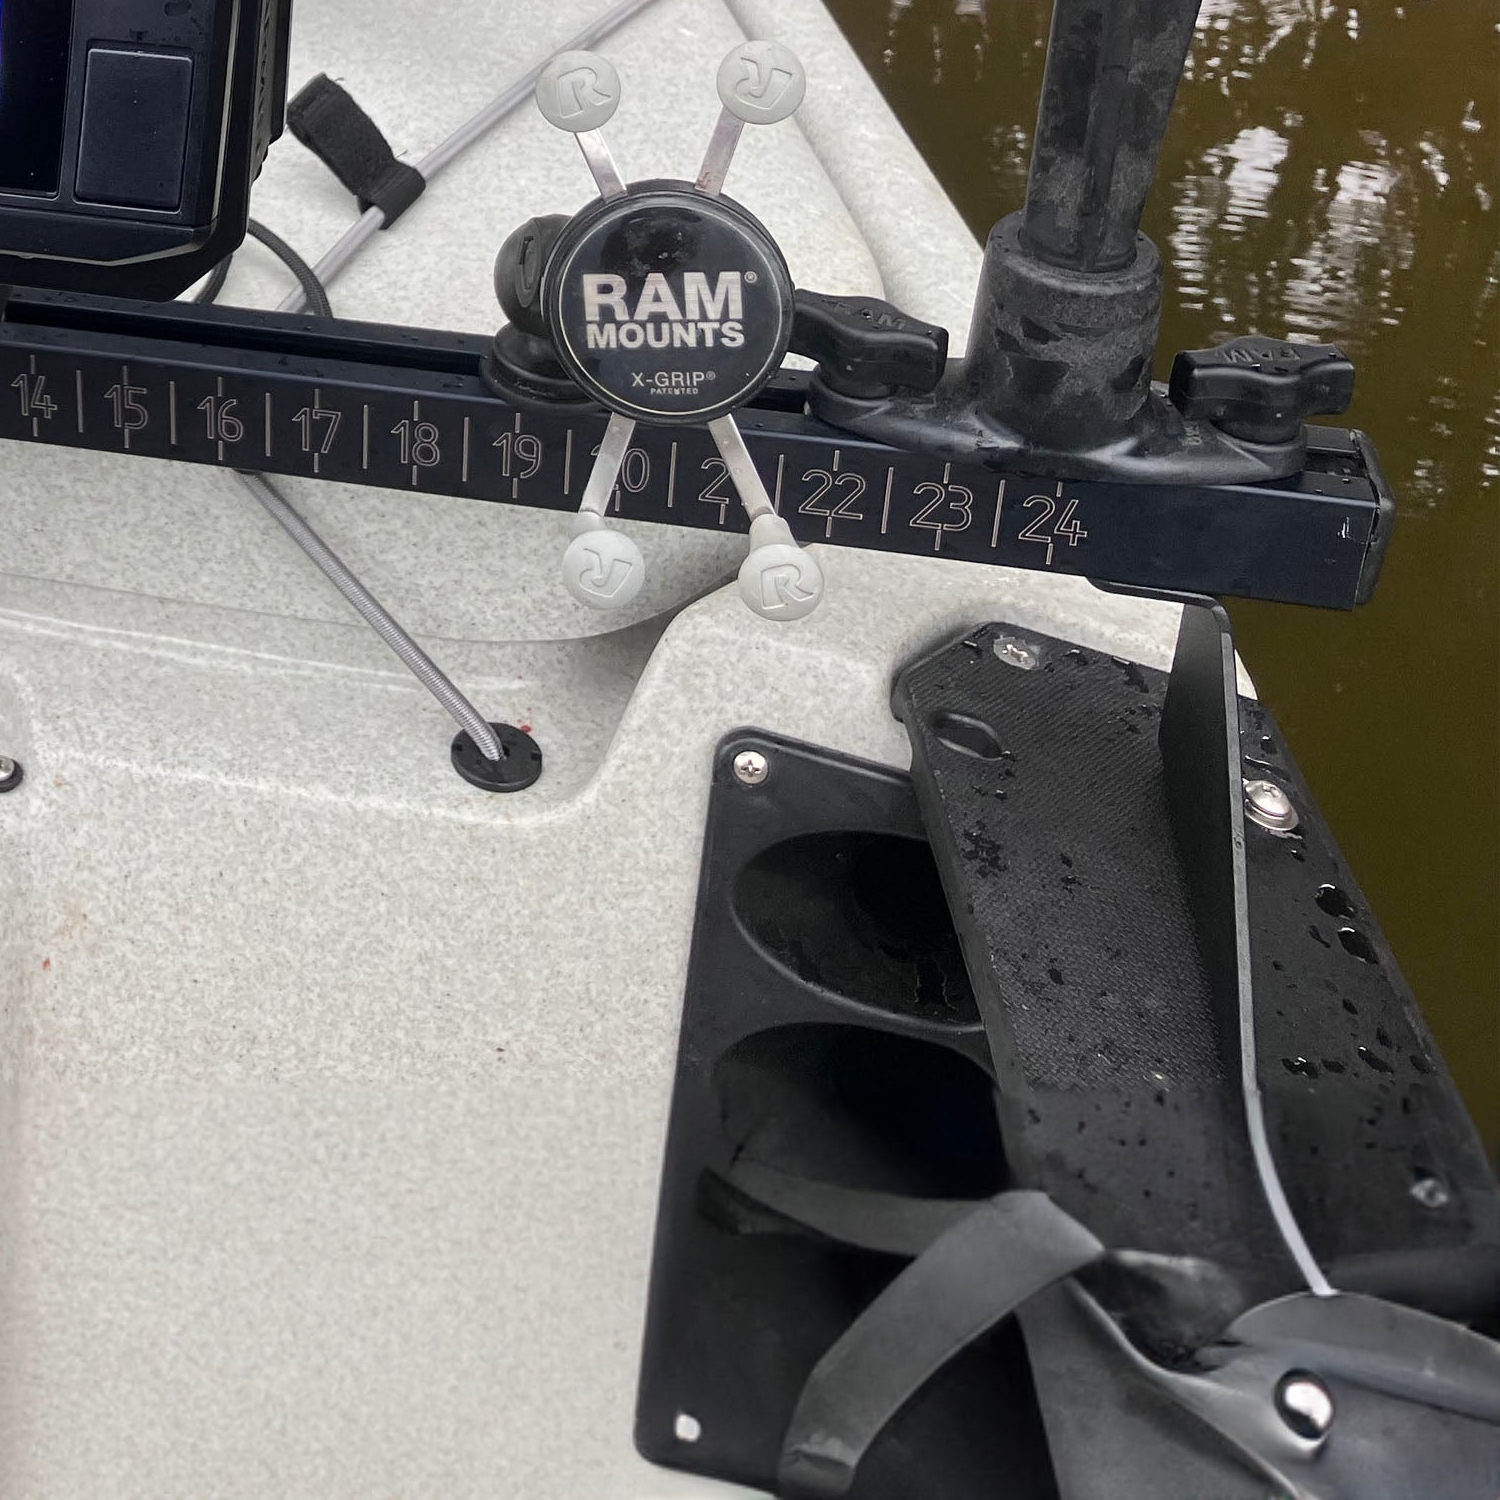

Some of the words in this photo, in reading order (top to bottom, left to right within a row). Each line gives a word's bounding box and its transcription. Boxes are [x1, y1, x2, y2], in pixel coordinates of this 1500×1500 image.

[586, 322, 745, 349] MOUNTS
[650, 387, 699, 395] PATENTED
[10, 373, 57, 420] 14
[104, 383, 148, 431] 15
[198, 396, 244, 443] 16
[292, 407, 342, 454] 17
[390, 419, 441, 468] 18
[492, 430, 542, 480] 19
[798, 468, 866, 521] 22
[909, 480, 973, 532] 23
[1018, 494, 1088, 546] 24
